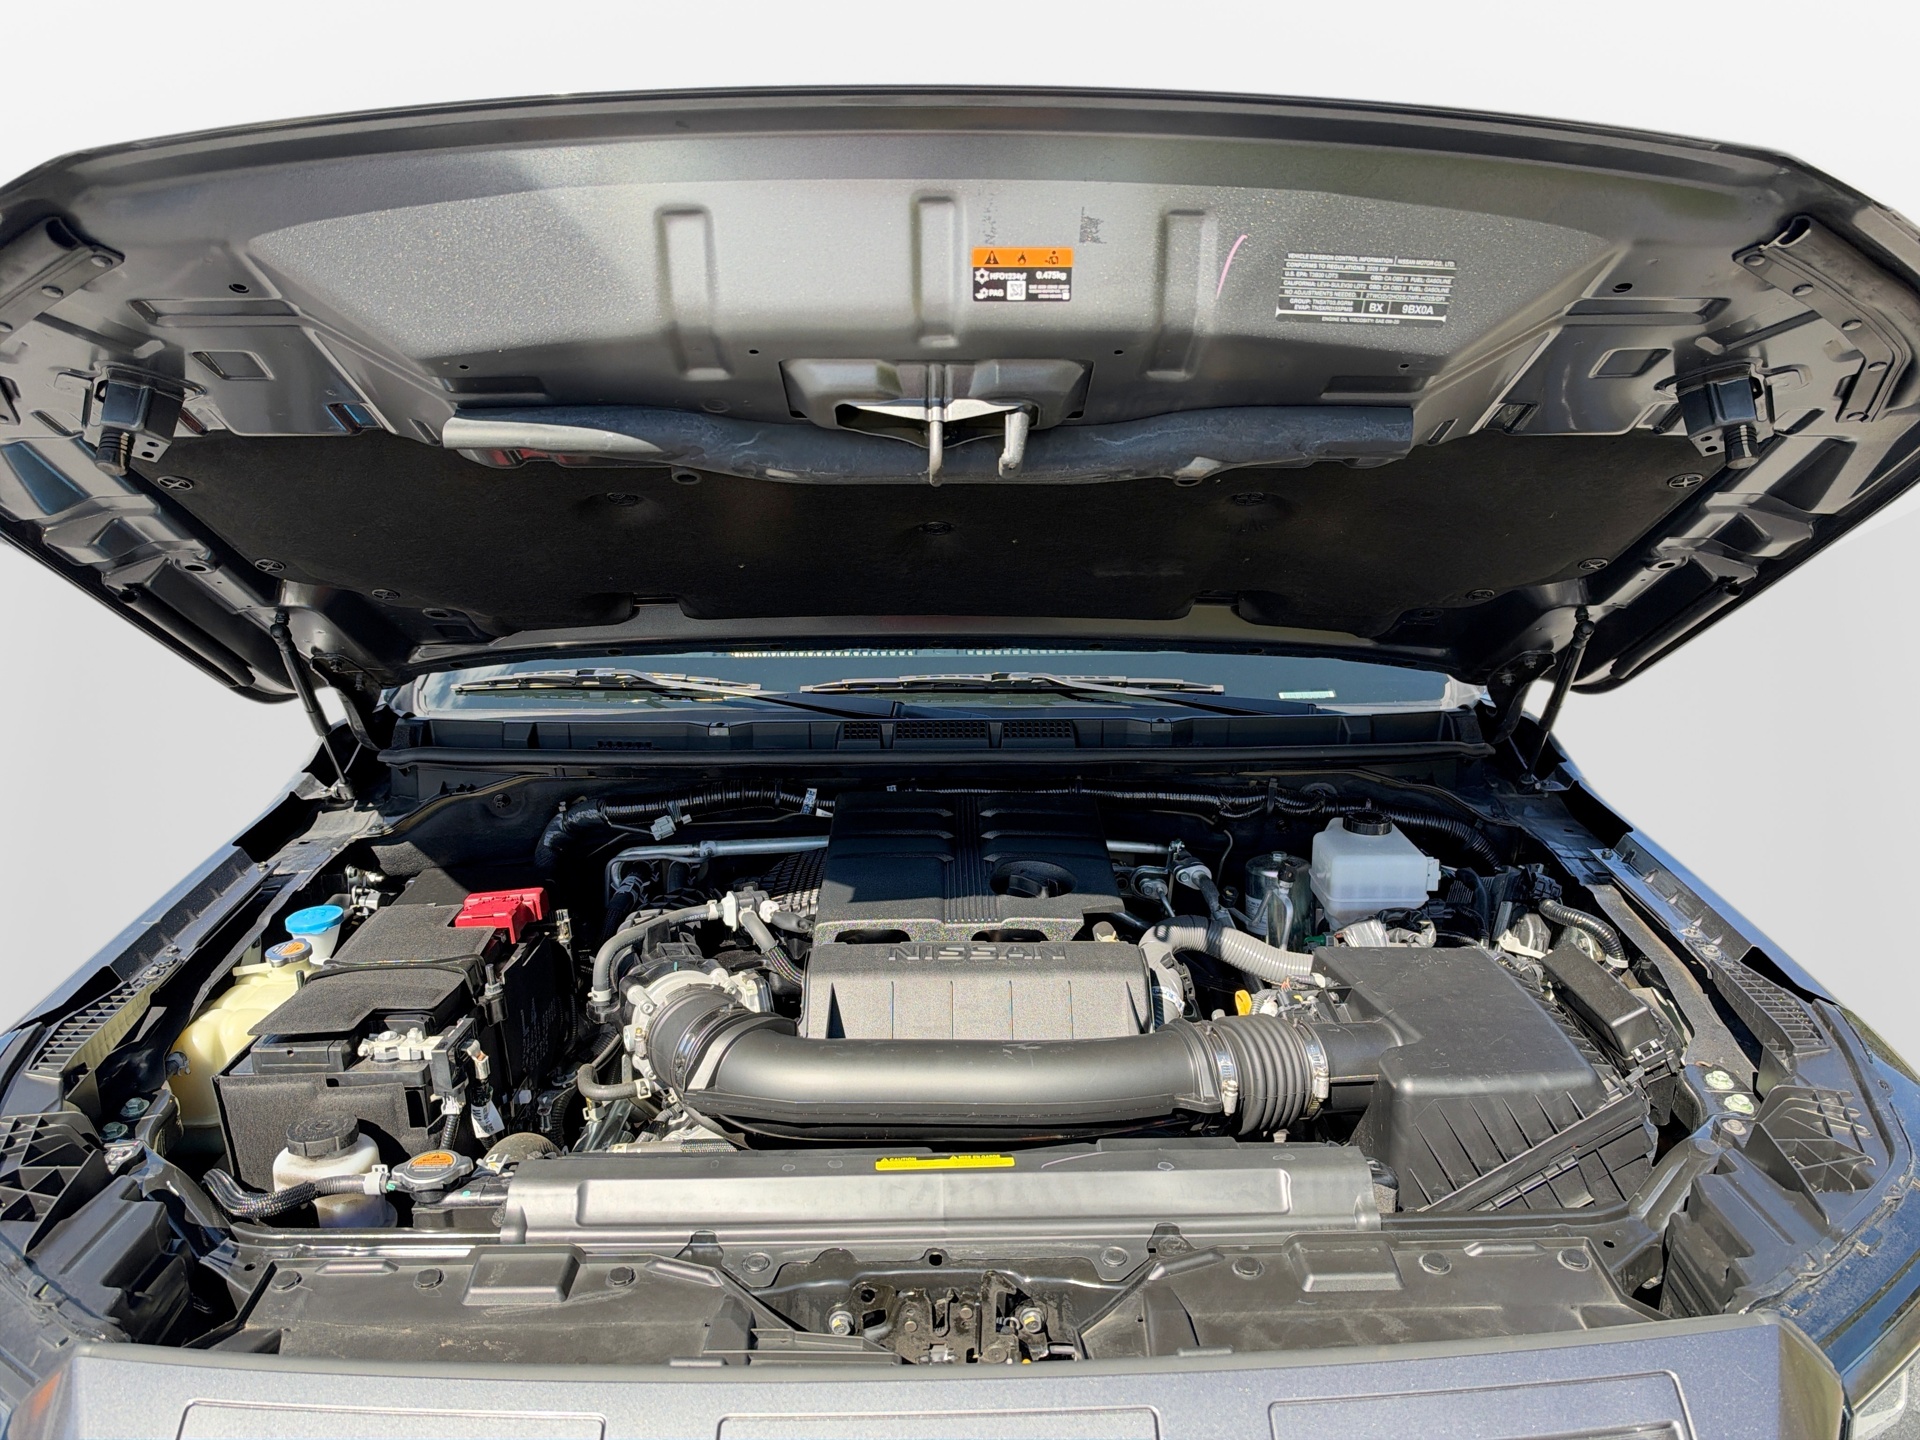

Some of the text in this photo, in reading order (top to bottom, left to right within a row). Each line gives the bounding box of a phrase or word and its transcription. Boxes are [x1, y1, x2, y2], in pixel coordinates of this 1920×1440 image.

[1310, 253, 1334, 261] EMISSION
[1359, 256, 1393, 264] INFORMATION
[1326, 263, 1365, 271] REGULATIONS:
[989, 288, 1004, 297] PAG
[1293, 289, 1333, 297] ADJUSTMENTS
[1369, 303, 1385, 313] BX
[888, 945, 1066, 960] NISSAN
